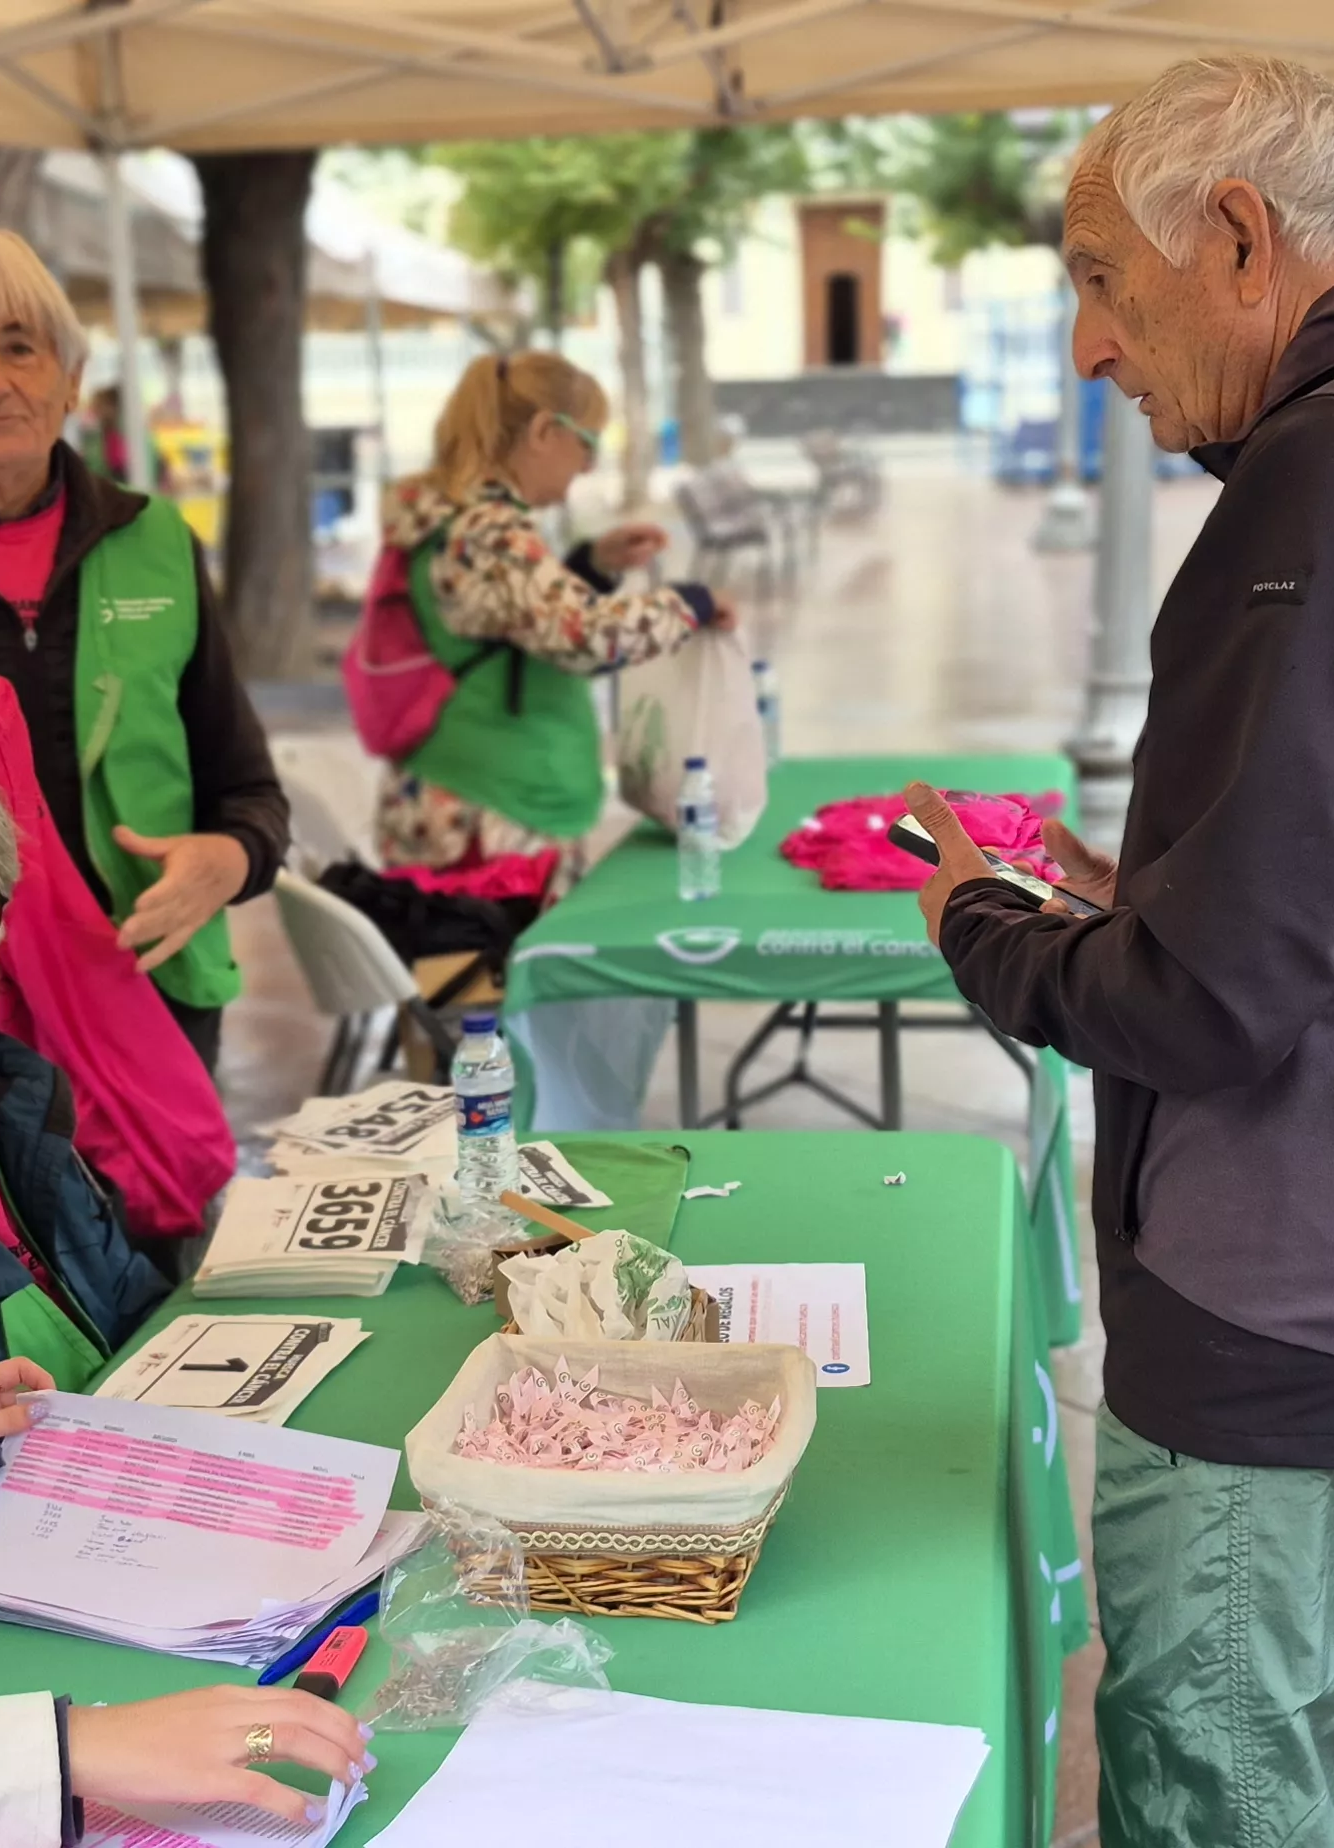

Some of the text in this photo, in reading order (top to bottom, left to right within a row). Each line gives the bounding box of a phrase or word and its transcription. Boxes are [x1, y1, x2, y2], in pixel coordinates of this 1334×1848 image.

[1252, 581, 1296, 593] FORCLAZ
[298, 1180, 383, 1251] 3659
[178, 1357, 250, 1373] 1
[227, 1329, 311, 1404] CONTRA EL CÁNCER
[273, 1354, 304, 1379] HUESCA
